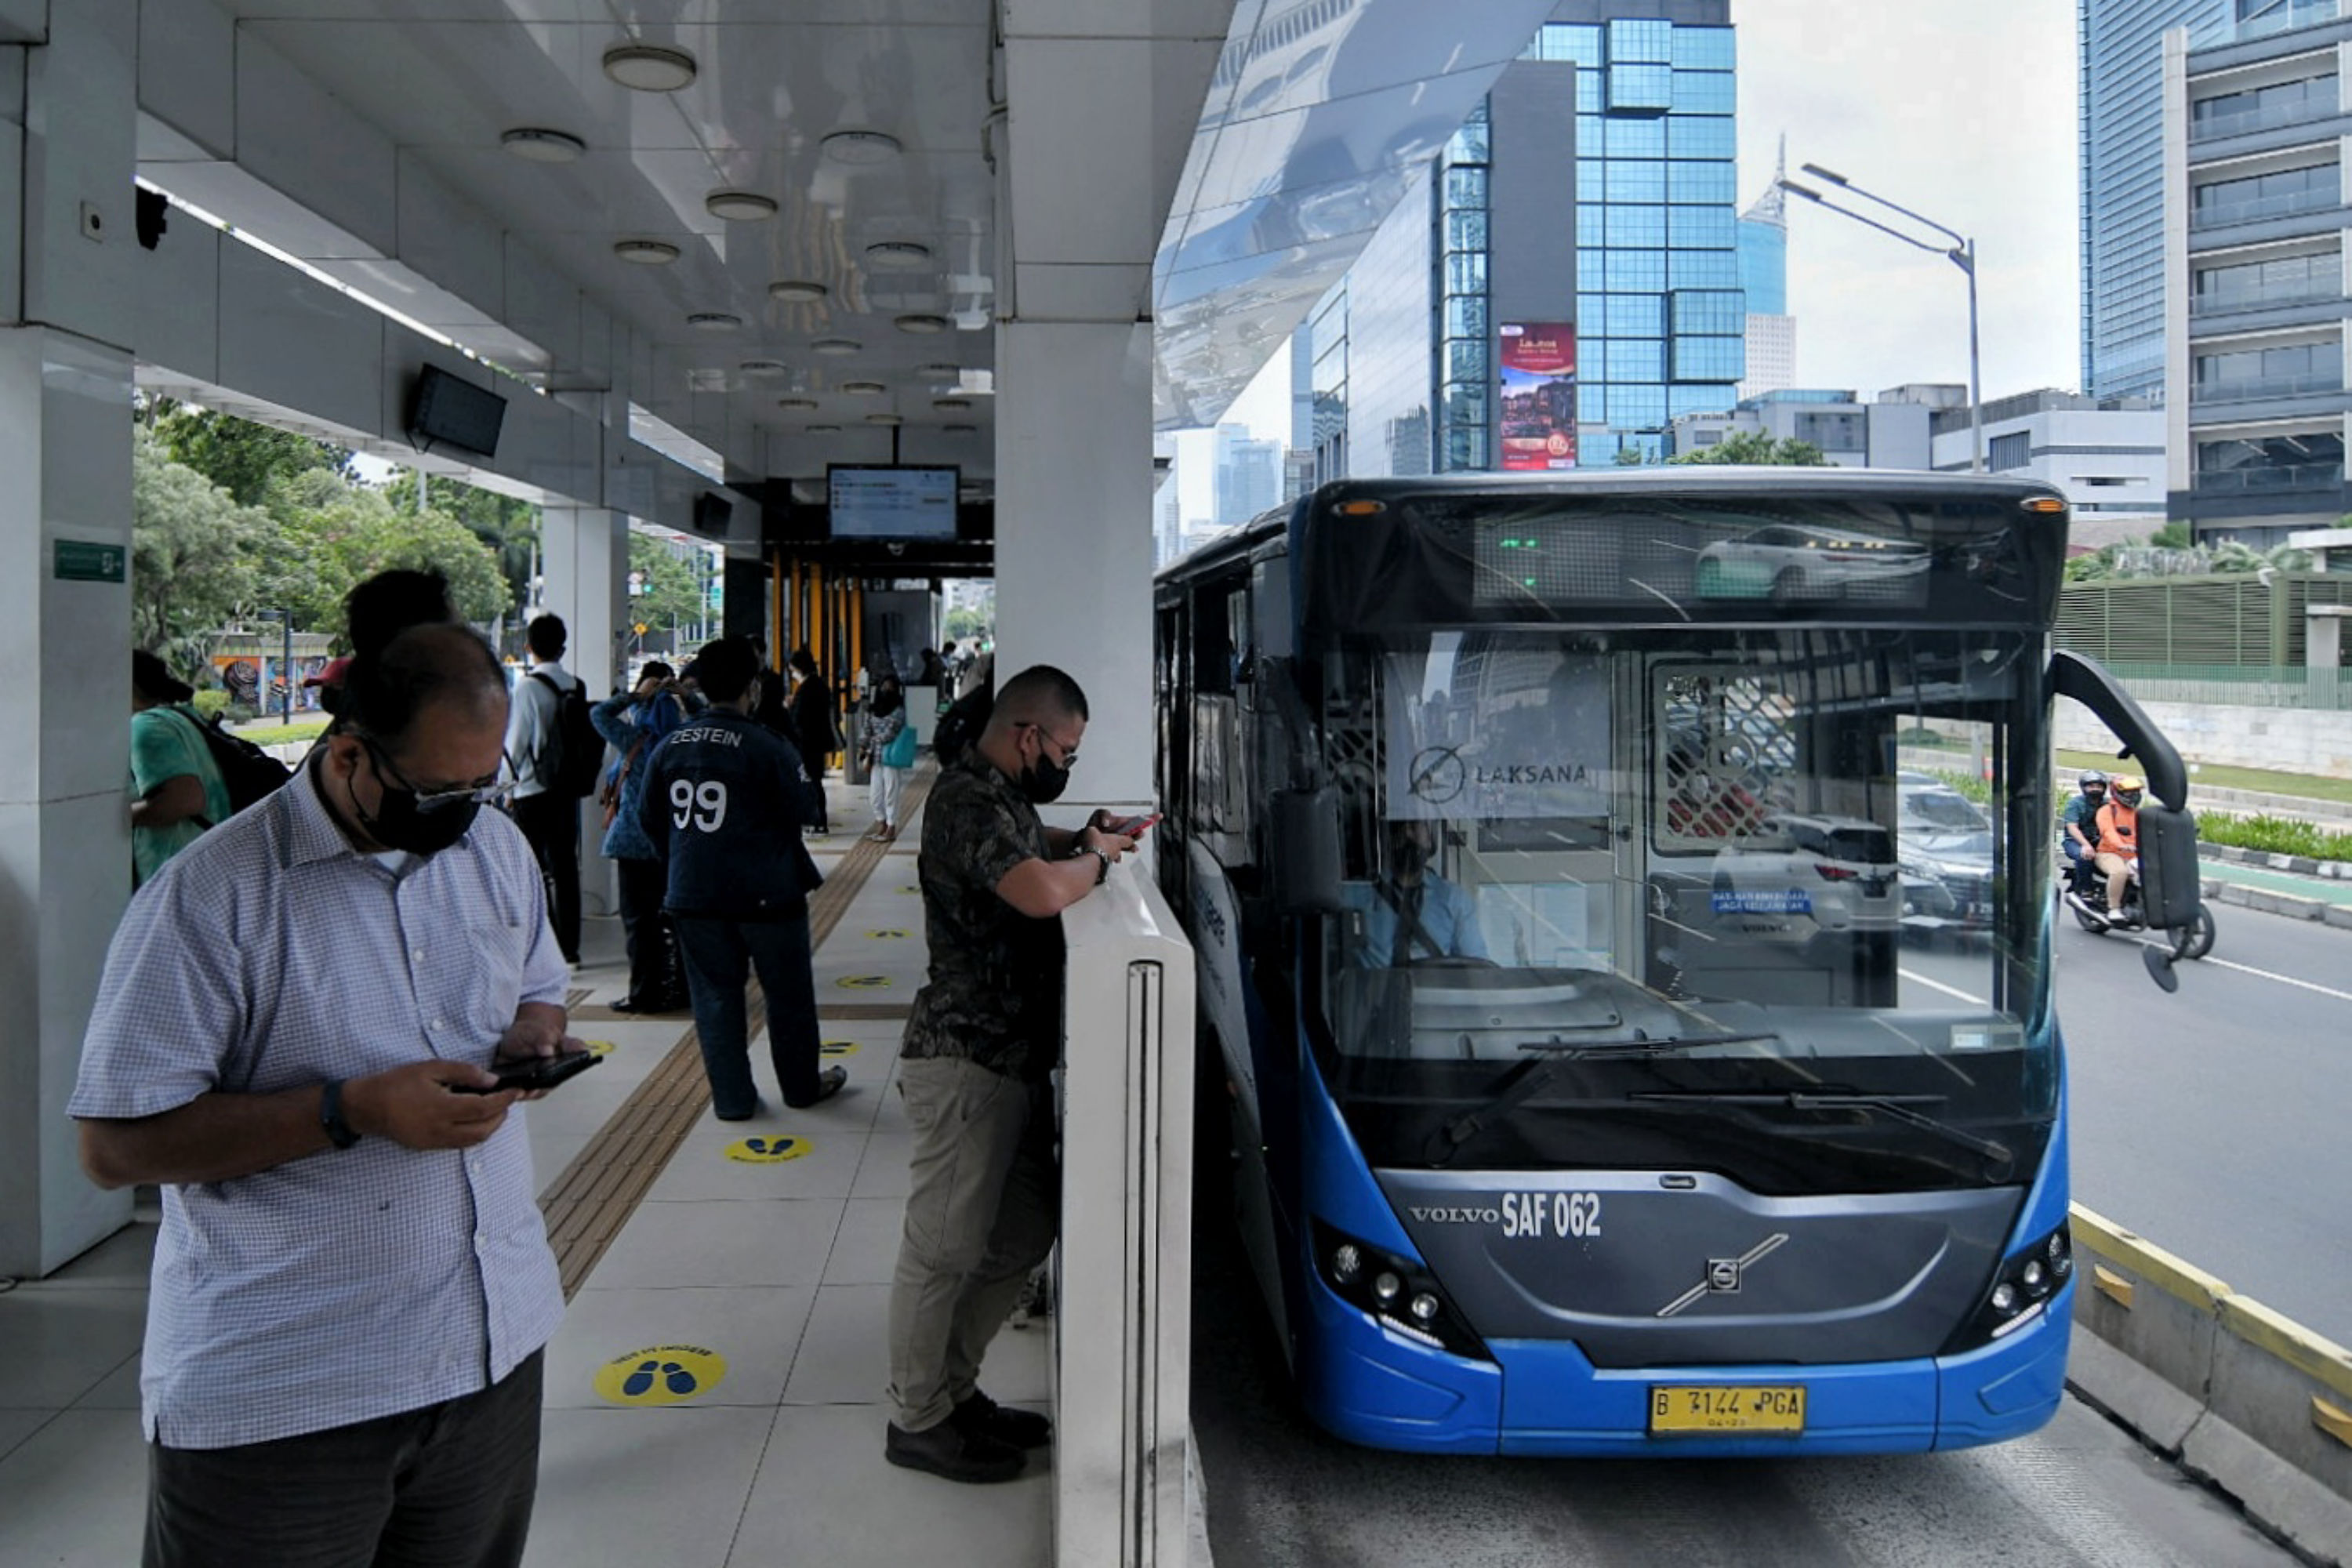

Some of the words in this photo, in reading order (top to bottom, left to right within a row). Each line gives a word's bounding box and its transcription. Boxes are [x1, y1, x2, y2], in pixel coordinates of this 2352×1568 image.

[670, 727, 742, 747] ZESTEIN
[1476, 764, 1585, 784] LAKSANA
[670, 779, 727, 833] 99
[1409, 1207, 1500, 1223] VOLVO
[1501, 1192, 1547, 1237] SAF
[1554, 1192, 1601, 1237] 062
[1657, 1393, 1668, 1415] B
[1688, 1392, 1740, 1414] 7144
[1761, 1392, 1799, 1414] PGA
